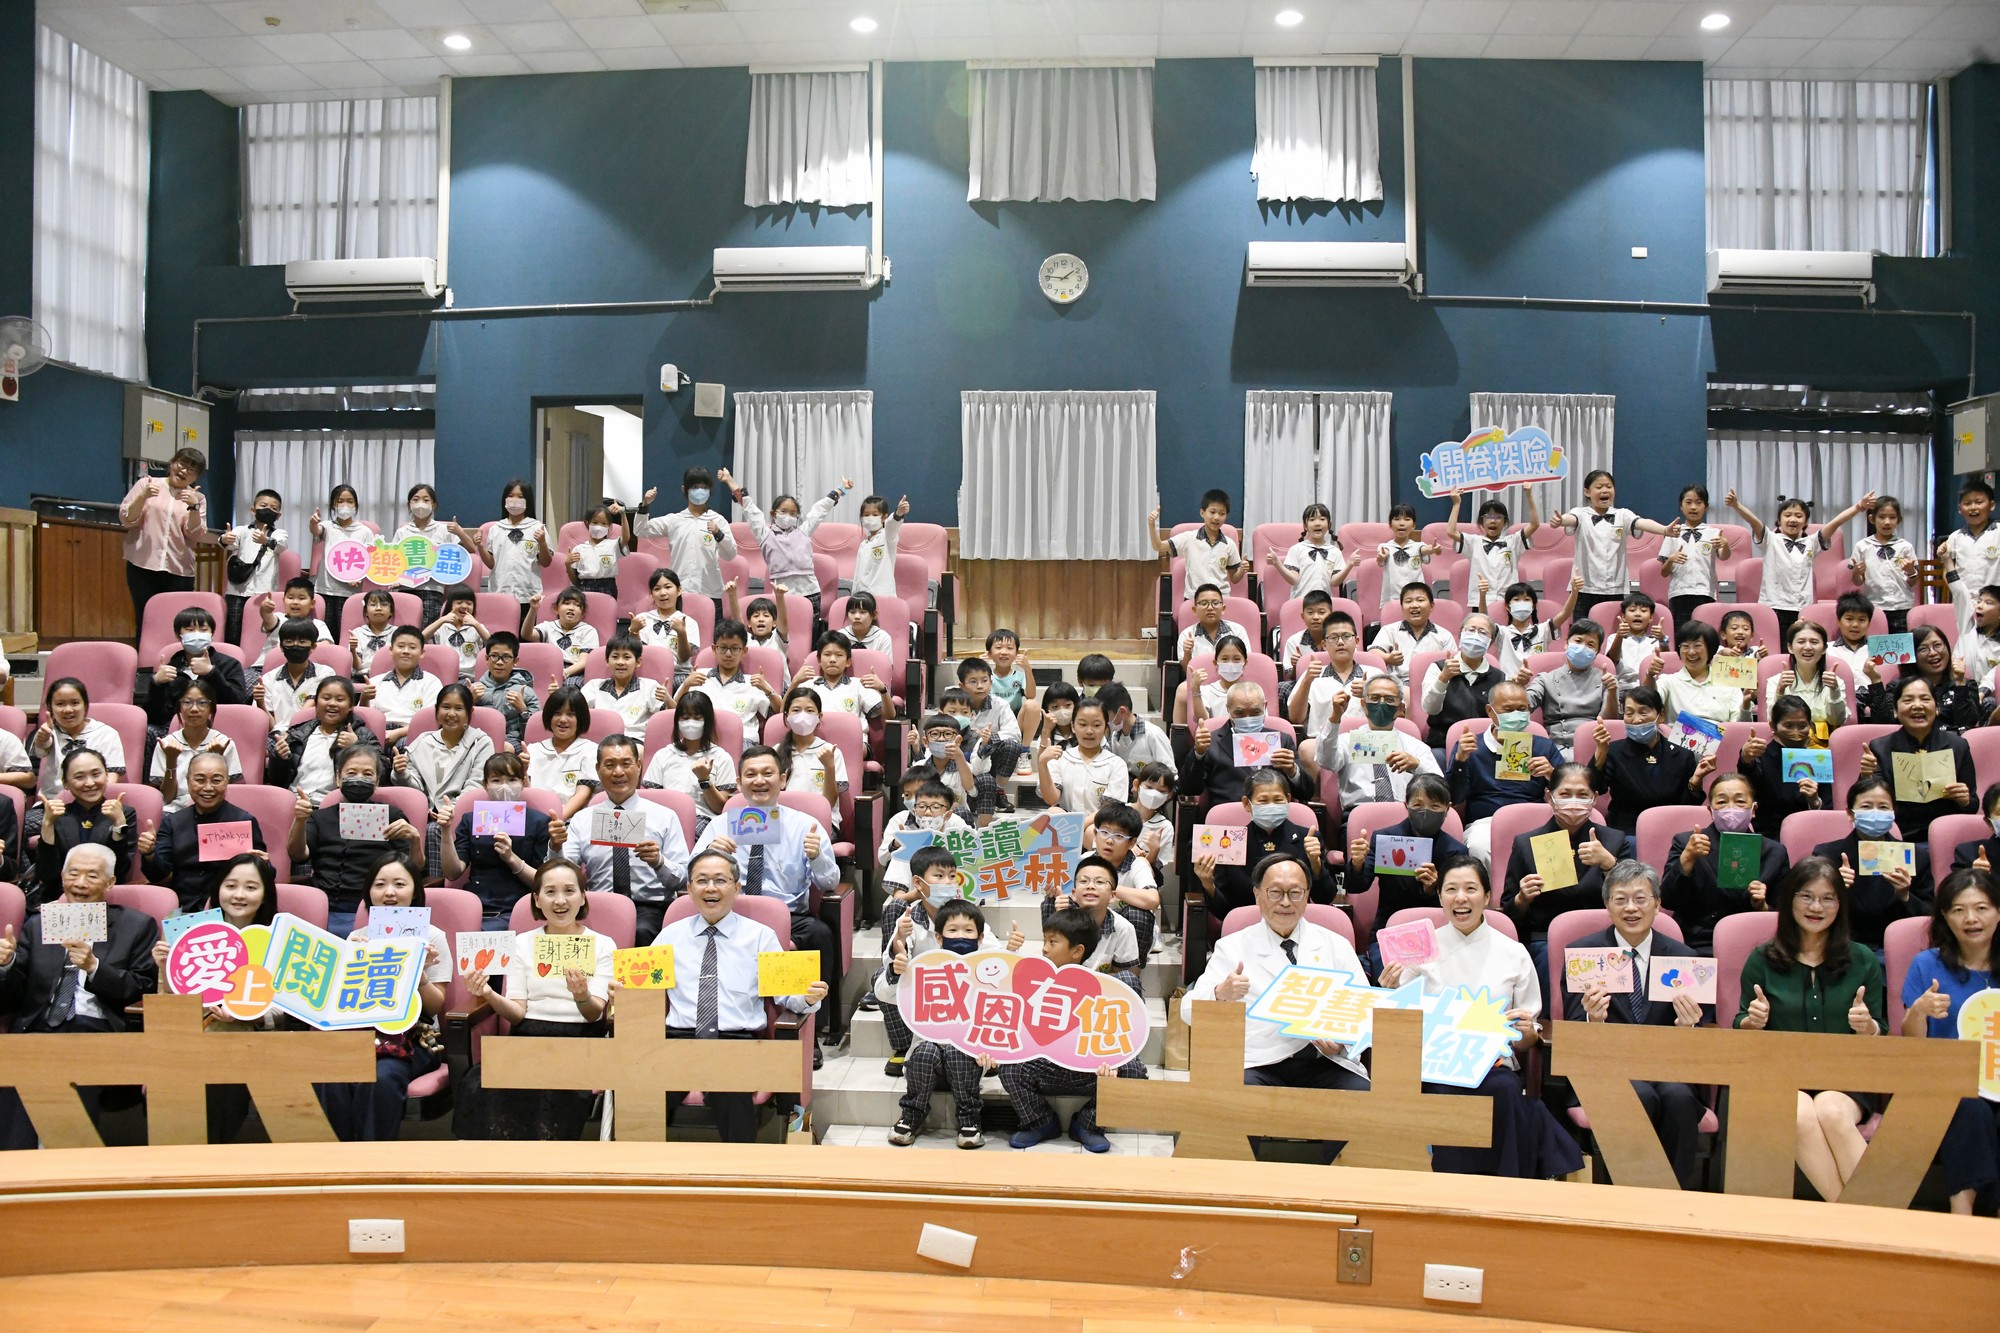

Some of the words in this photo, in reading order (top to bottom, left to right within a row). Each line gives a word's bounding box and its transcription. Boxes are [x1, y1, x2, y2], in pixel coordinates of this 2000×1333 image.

[1439, 436, 1550, 486] 開卷探險
[333, 540, 462, 576] 快樂書蟲
[932, 820, 1024, 868] 樂讀
[979, 853, 1071, 900] 平林
[178, 928, 409, 1011] 愛上閱讀
[539, 938, 592, 963] 謝謝
[913, 962, 1134, 1056] 感恩有您
